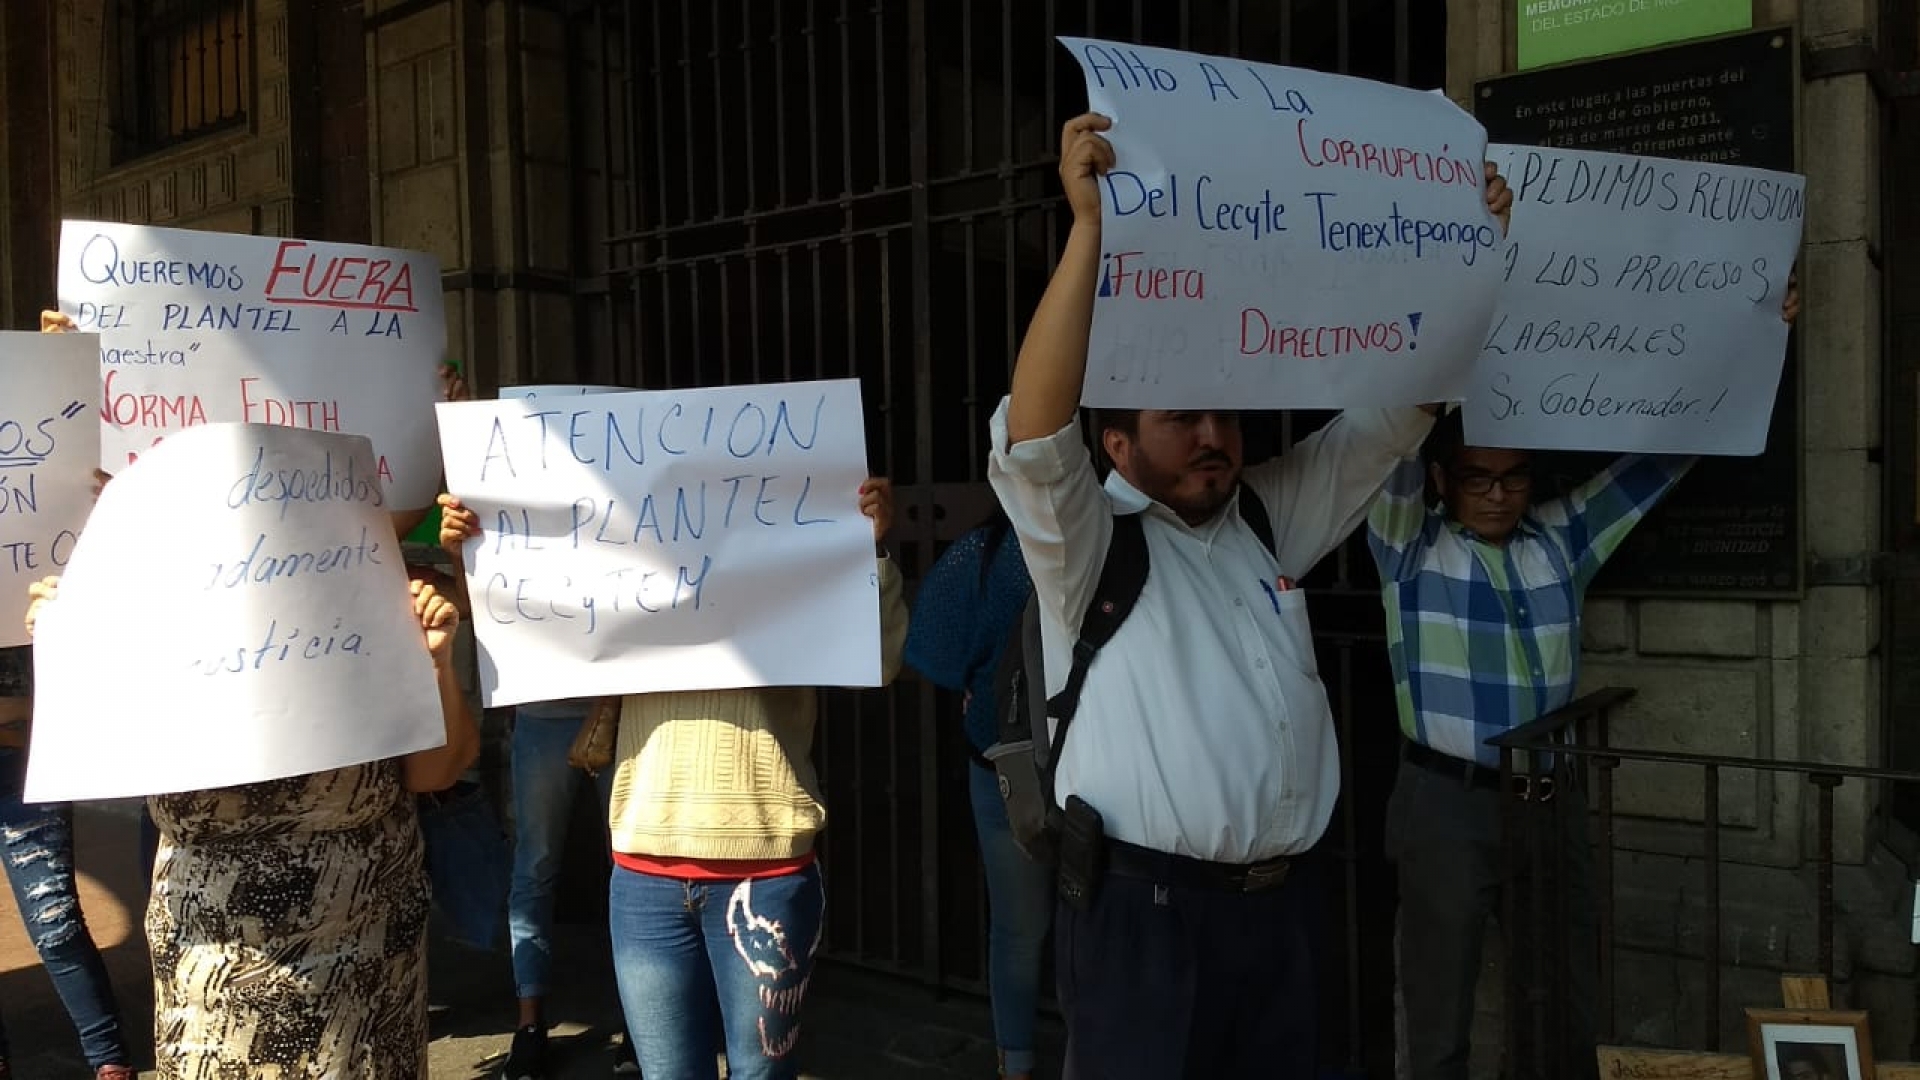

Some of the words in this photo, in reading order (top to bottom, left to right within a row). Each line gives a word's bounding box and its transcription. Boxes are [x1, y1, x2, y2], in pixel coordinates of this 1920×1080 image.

[1532, 17, 1560, 33] DEL
[1564, 3, 1626, 25] ESTADO
[1200, 61, 1239, 101] A
[1247, 66, 1314, 115] La
[1515, 105, 1532, 118] En
[1537, 101, 1566, 114] este
[1571, 92, 1611, 109] lugar,
[1625, 85, 1648, 99] las
[1653, 77, 1713, 97] puertas
[1720, 68, 1744, 84] del
[1548, 112, 1603, 131] Palacio
[1608, 107, 1626, 121] de
[1580, 130, 1597, 144] de
[1604, 122, 1651, 140] marzo
[1657, 118, 1675, 132] de
[1698, 129, 1733, 145] ante
[1298, 118, 1478, 188] CORRUPCIÓN
[1105, 171, 1178, 218] Del
[1196, 175, 1288, 240] Cecyte
[1688, 171, 1804, 222] REVISION
[80, 233, 244, 292] QUEREMOS
[265, 240, 415, 308] FUERA
[1098, 251, 1204, 300] ¡Fuera
[1535, 251, 1600, 287] LOS
[1614, 254, 1771, 303] PROCESOS
[78, 302, 131, 331] DEL
[162, 303, 302, 333] PLANTEL
[330, 309, 349, 334] A
[364, 309, 403, 339] LA
[1240, 308, 1424, 359] DIRECTIVOS!
[1484, 314, 1687, 357] LABORALES
[481, 395, 826, 481] ATENCION
[228, 446, 384, 521] despedidos
[494, 508, 546, 554] AL
[571, 475, 838, 549] PLANTEL
